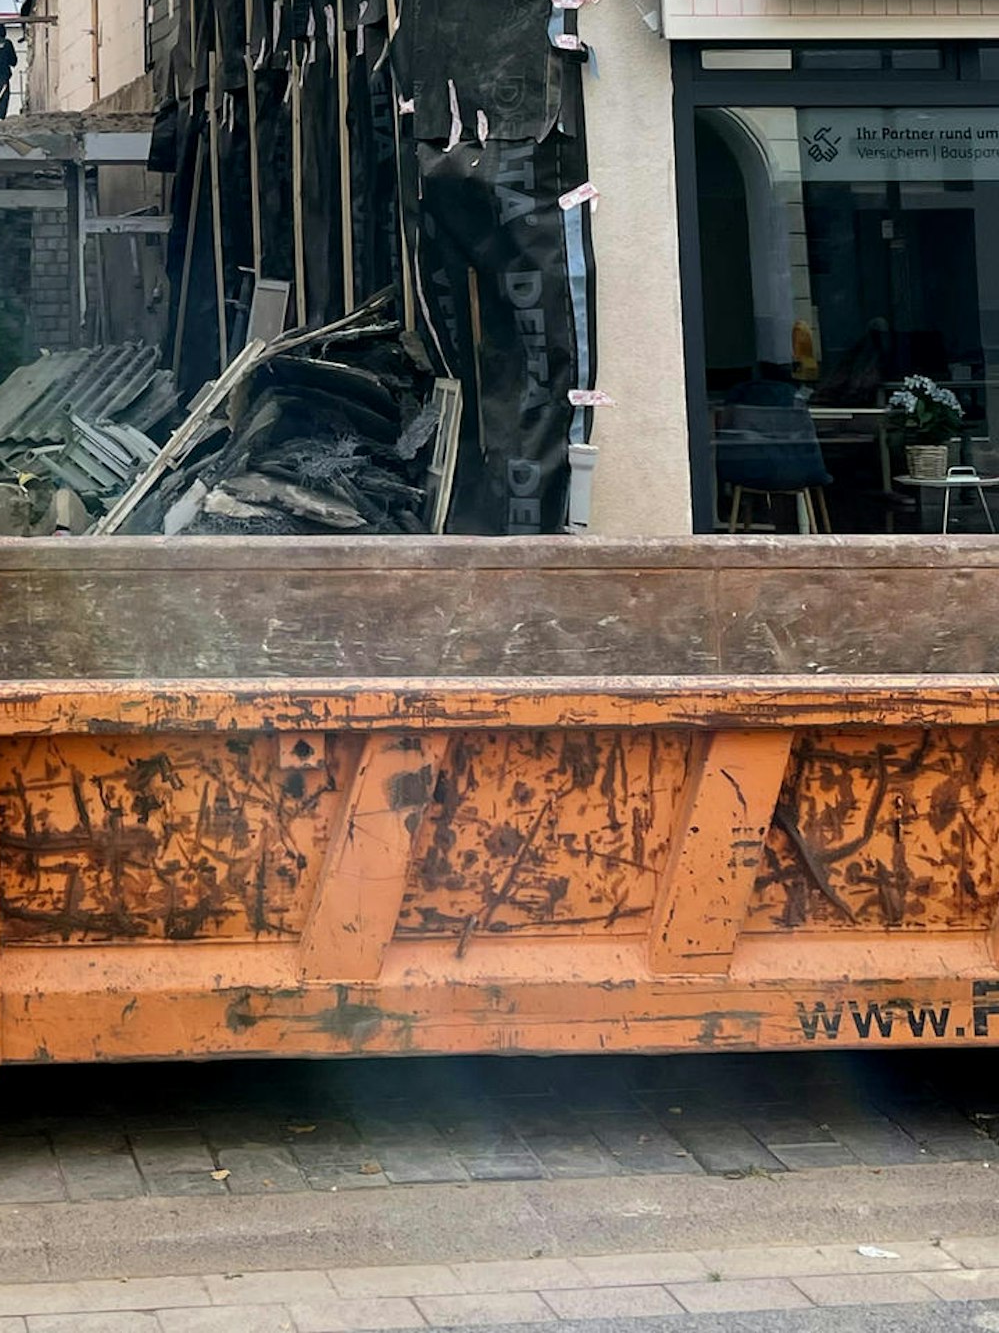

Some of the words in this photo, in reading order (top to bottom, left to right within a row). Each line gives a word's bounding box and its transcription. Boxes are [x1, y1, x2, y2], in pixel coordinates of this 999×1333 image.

[857, 128, 876, 140] Ihr
[882, 128, 933, 140] Partner
[940, 127, 971, 139] rund
[977, 130, 998, 139] um
[857, 146, 928, 159] Versichern
[506, 270, 552, 413] DELTA
